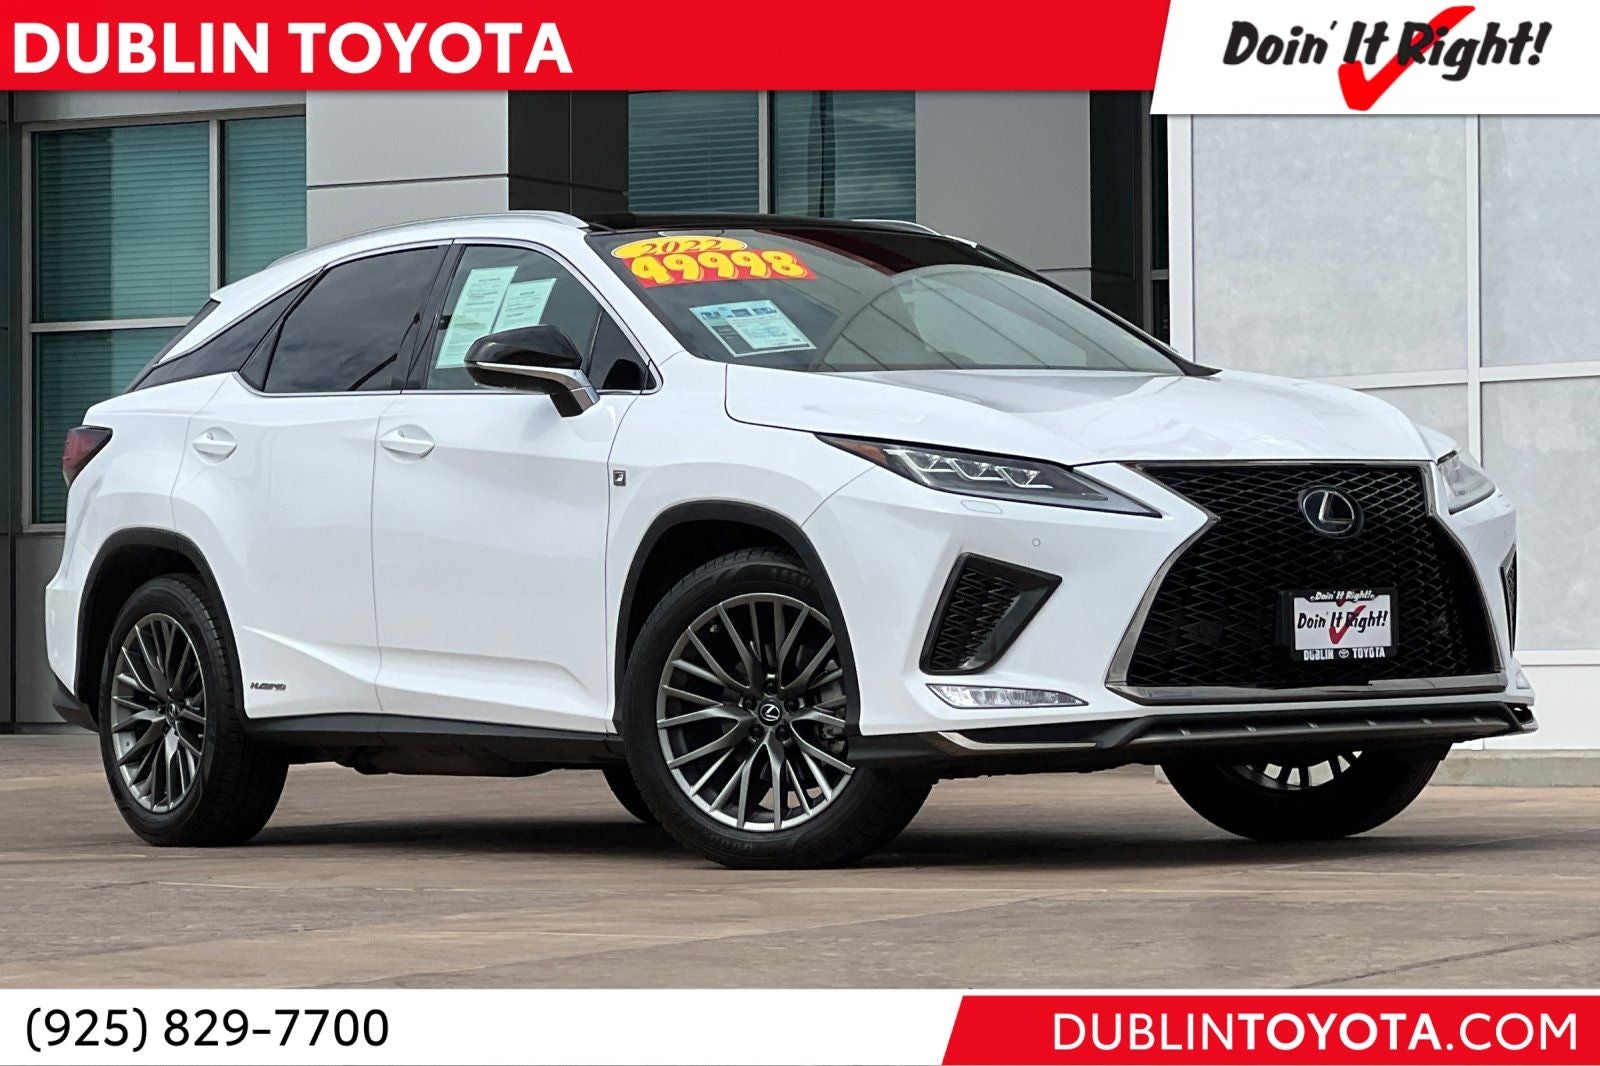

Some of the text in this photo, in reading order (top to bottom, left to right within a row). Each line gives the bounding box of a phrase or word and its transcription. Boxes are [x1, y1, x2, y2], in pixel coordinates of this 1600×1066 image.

[641, 239, 722, 255] 2022
[631, 250, 808, 285] 49998
[1330, 611, 1343, 628] It
[1346, 610, 1388, 633] Right!
[1303, 647, 1385, 661] DUBLIN TOYOTA
